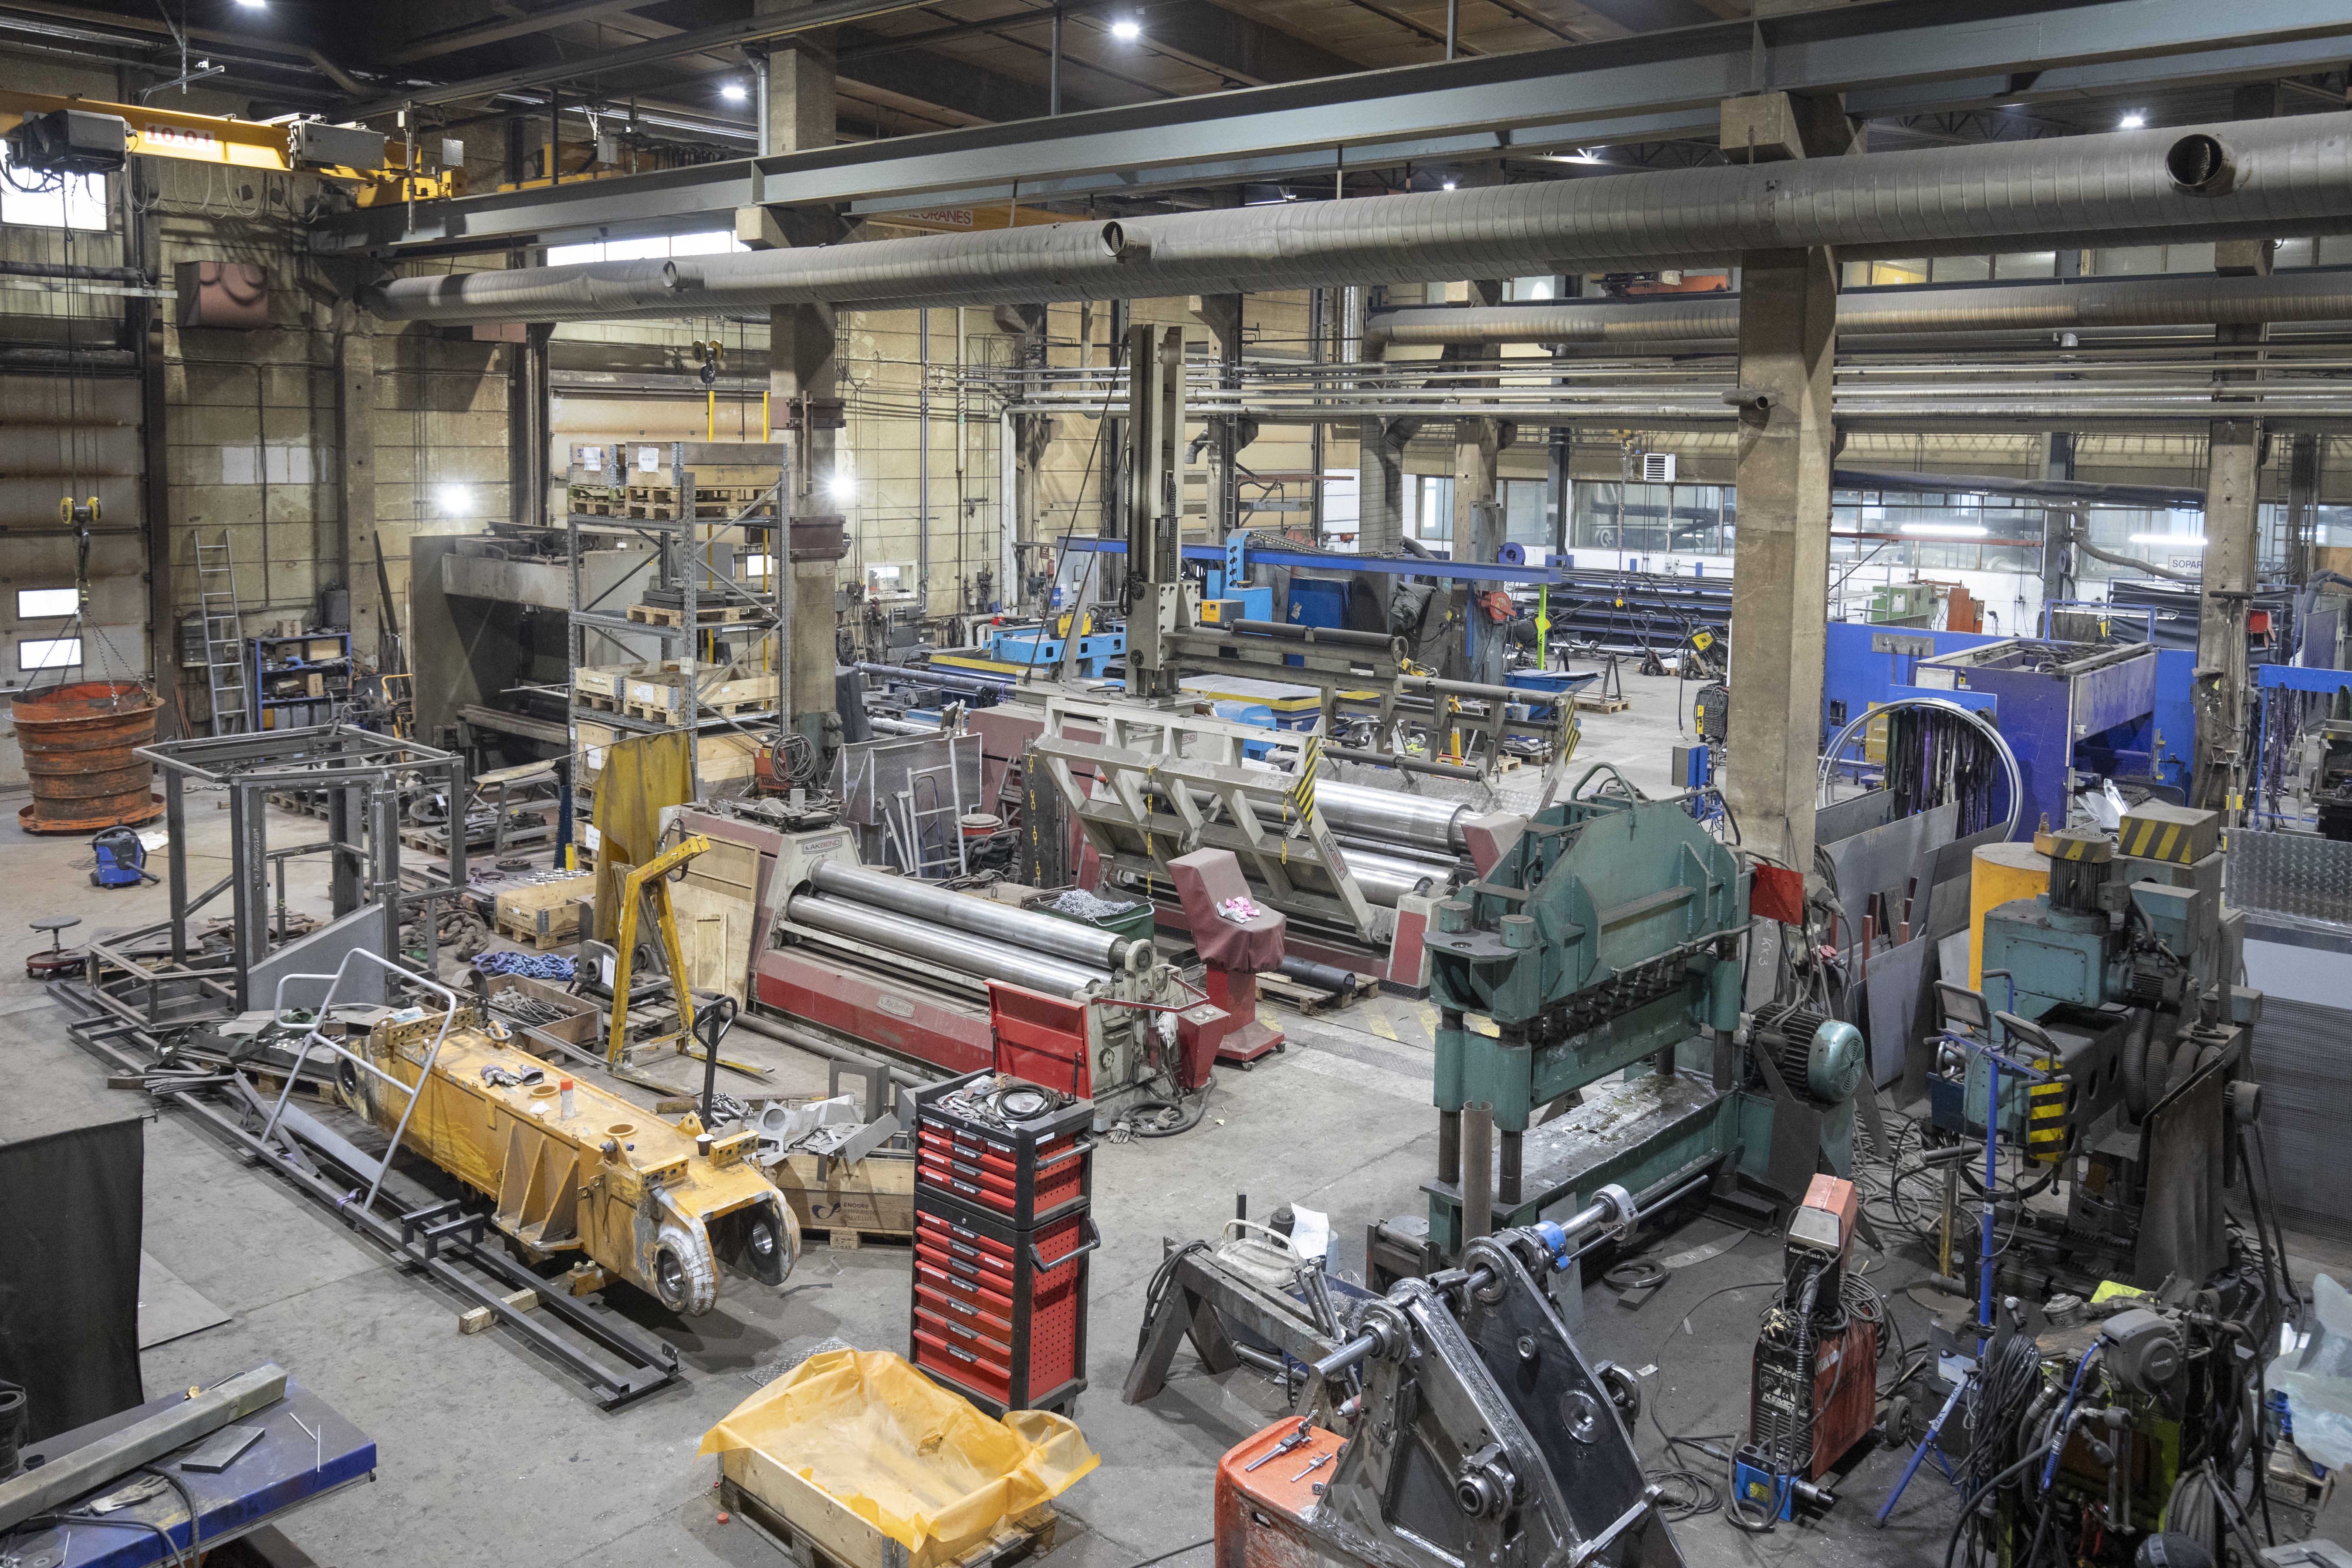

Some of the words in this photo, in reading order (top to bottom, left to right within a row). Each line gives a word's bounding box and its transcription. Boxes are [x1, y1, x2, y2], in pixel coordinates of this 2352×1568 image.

[148, 125, 197, 145] 10.0
[203, 133, 211, 148] t
[810, 839, 840, 850] AKBEND
[1326, 843, 1345, 875] AKBEND
[505, 906, 530, 919] HYDCAND
[885, 999, 912, 1014] AKBEND
[1774, 1365, 1797, 1379] 3200
